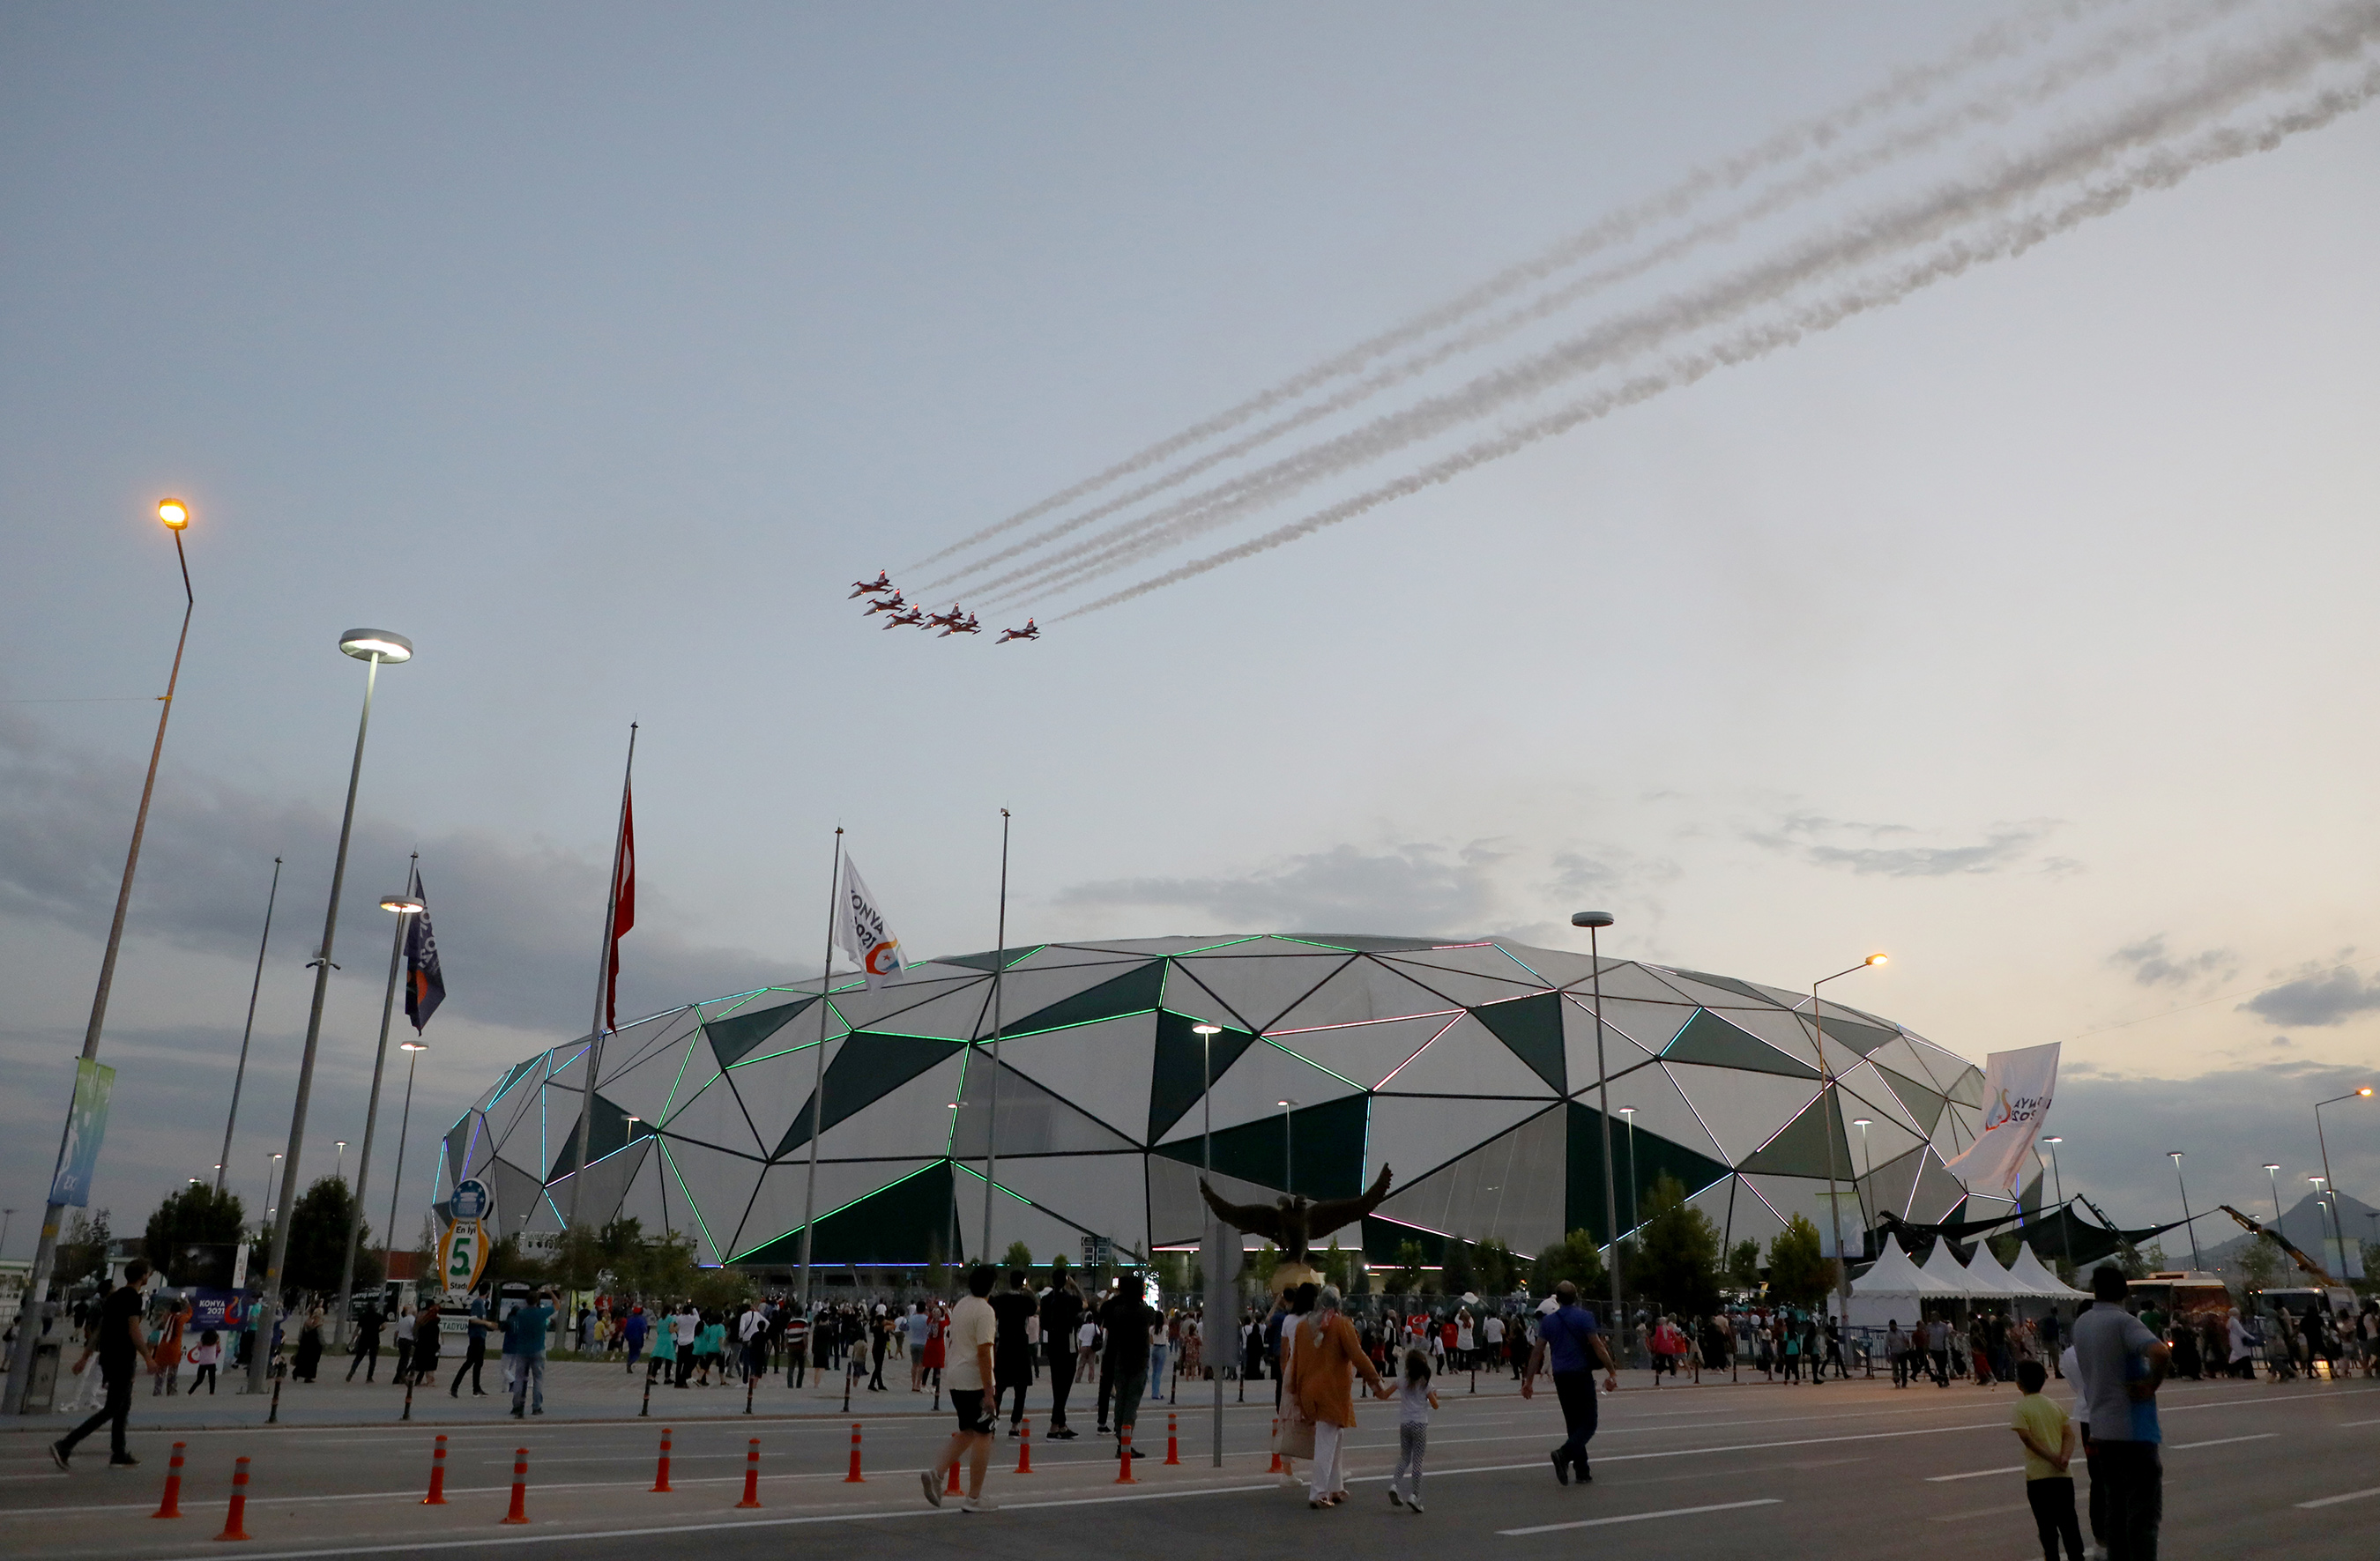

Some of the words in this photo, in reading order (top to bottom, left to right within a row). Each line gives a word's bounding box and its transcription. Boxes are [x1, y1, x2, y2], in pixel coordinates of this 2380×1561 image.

[851, 889, 883, 935] ONYA
[854, 917, 877, 949] 021
[439, 1322, 469, 1331] TADYUM
